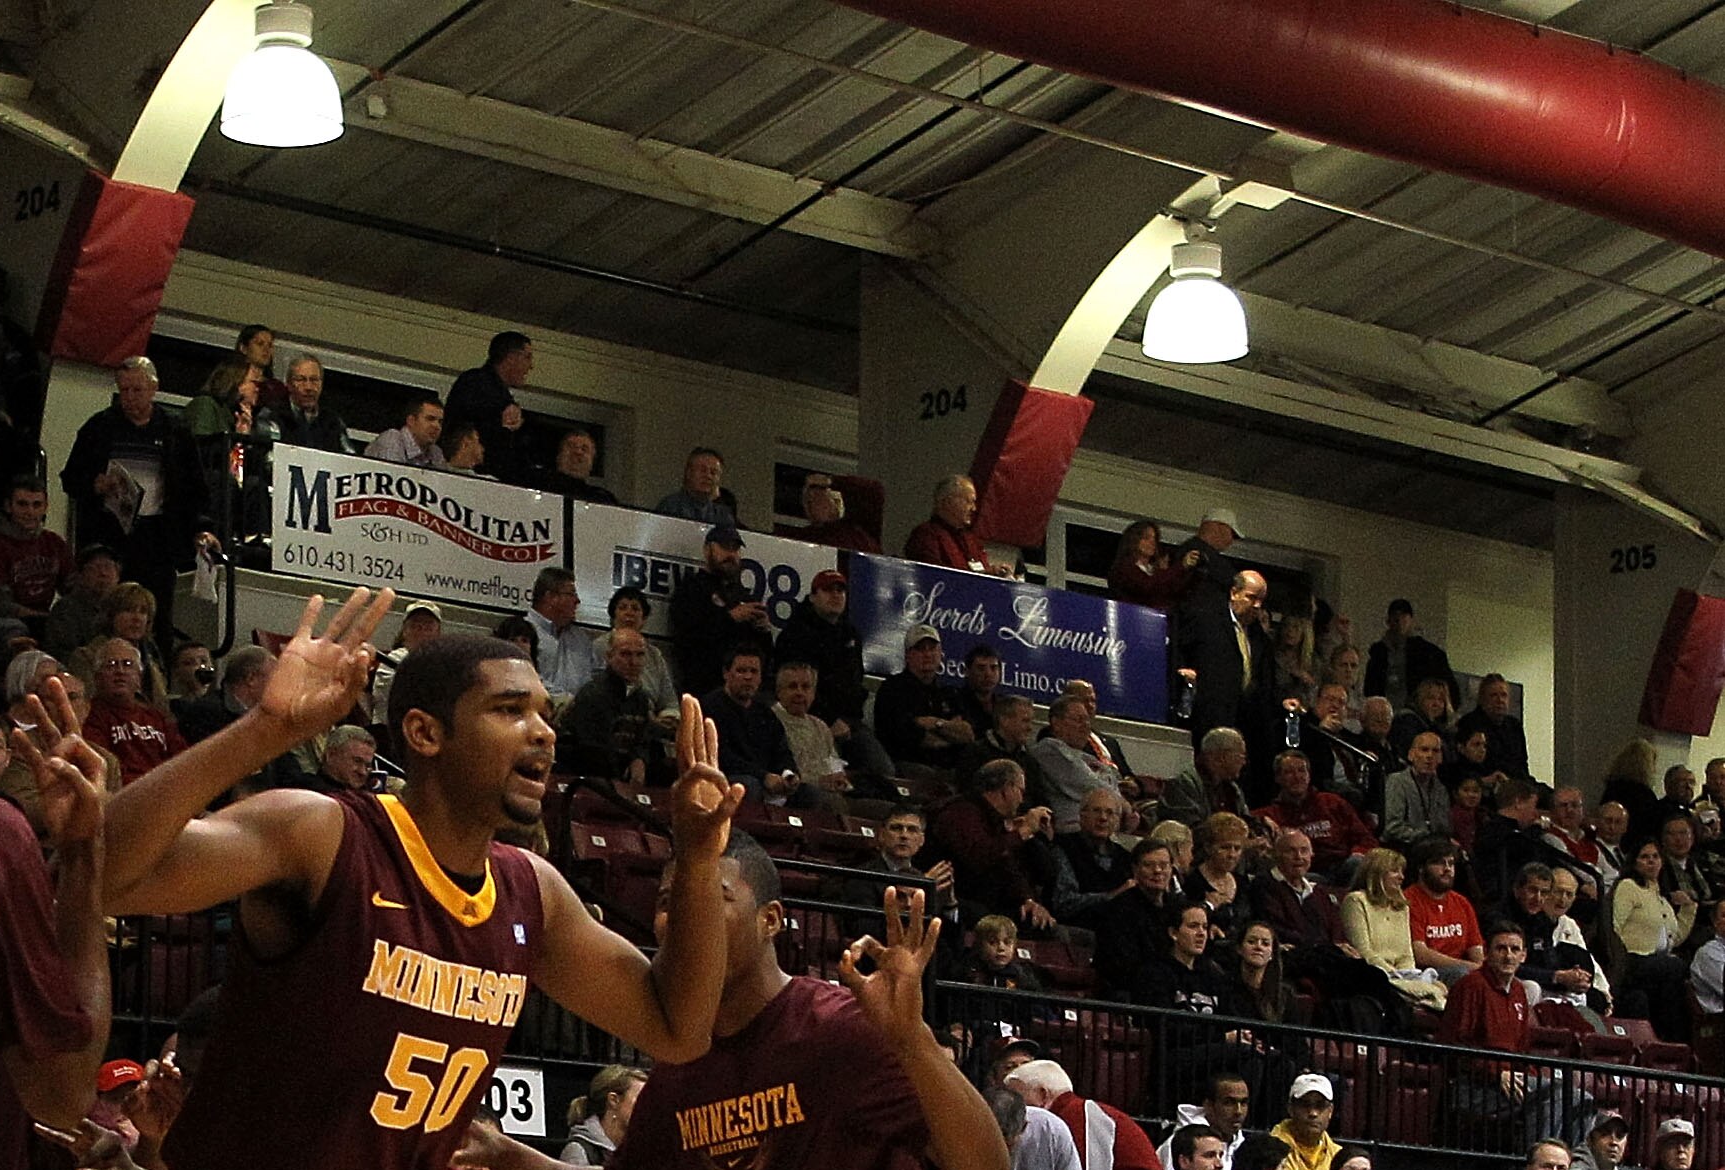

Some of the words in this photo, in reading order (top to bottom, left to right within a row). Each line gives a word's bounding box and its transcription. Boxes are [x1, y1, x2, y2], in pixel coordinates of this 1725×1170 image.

[16, 181, 60, 220] 204
[919, 384, 966, 420] 204
[284, 464, 551, 543] METROPOLITAN
[338, 499, 388, 516] FLAG
[396, 505, 410, 518] &
[416, 510, 493, 557] BANNER
[361, 523, 403, 543] S&H
[283, 543, 405, 582] 610.431.3524
[1610, 544, 1657, 573] 205
[425, 571, 533, 603] www.metflag.c
[903, 581, 989, 635] Secrets
[998, 595, 1127, 658] Limousine
[1426, 923, 1463, 938] CHAMPS
[370, 1032, 490, 1135] 50
[491, 1077, 534, 1122] 03
[676, 1082, 806, 1151] MINNESOTA
